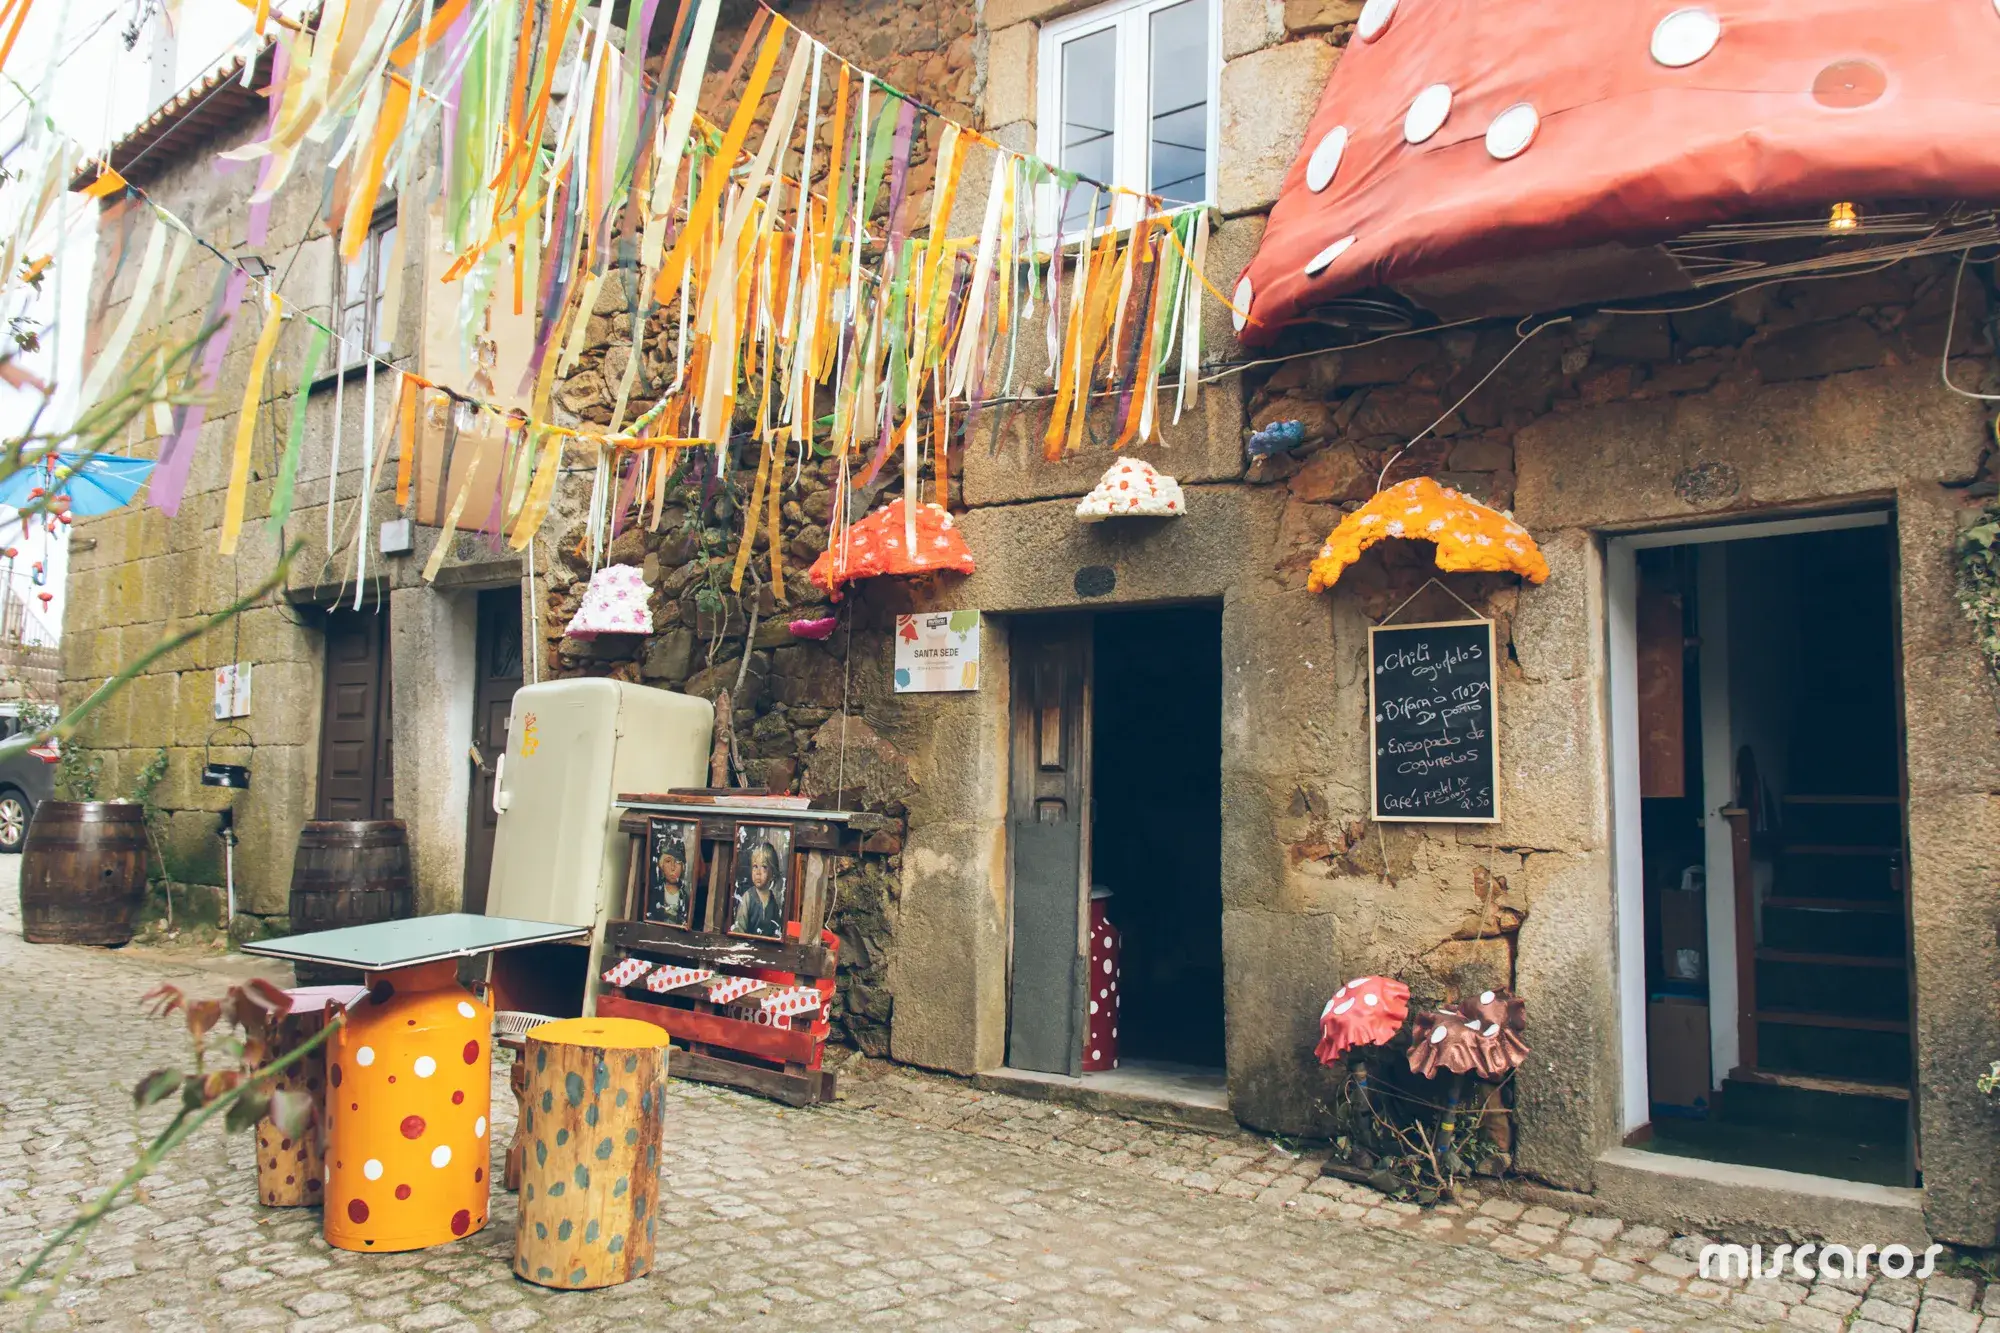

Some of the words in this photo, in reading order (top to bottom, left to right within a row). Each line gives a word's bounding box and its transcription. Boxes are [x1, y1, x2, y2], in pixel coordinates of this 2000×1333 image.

[914, 649, 938, 658] SANTA
[940, 648, 959, 657] SEDE
[1385, 643, 1429, 670] Chili
[1388, 729, 1461, 757] Ensopado
